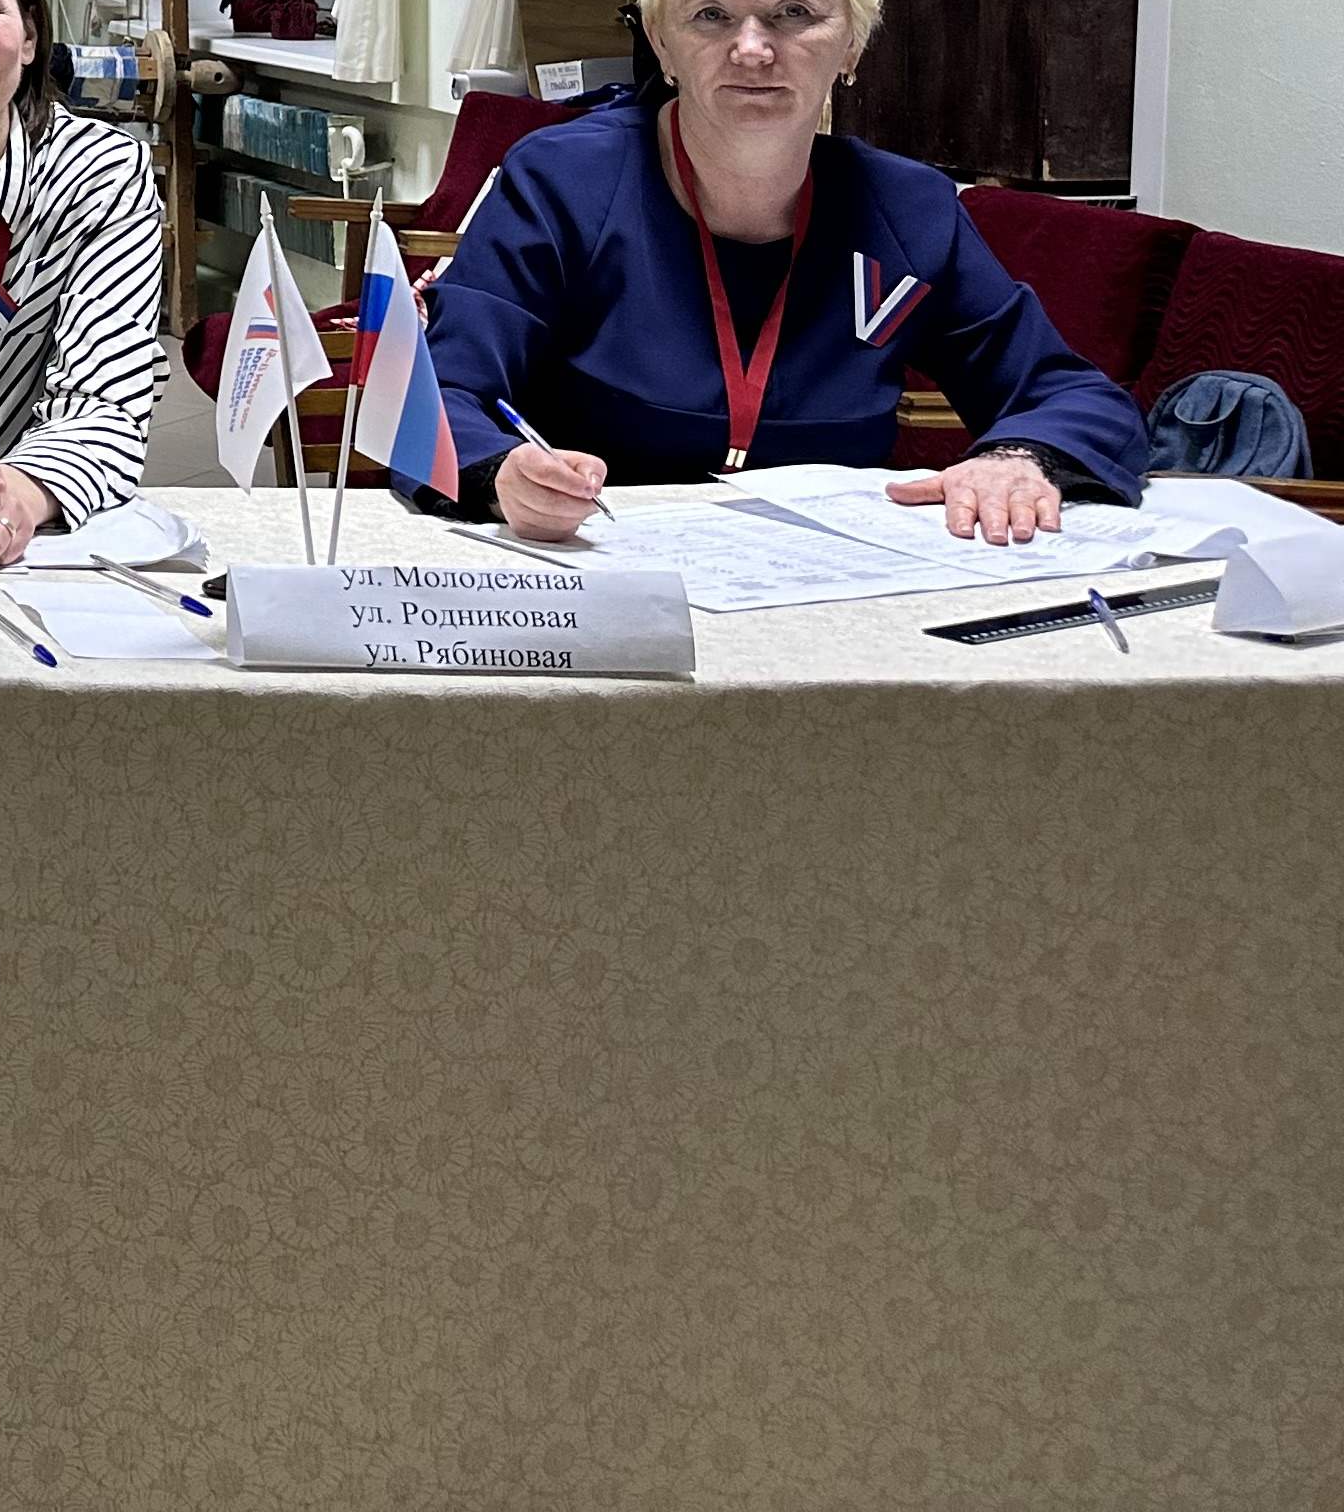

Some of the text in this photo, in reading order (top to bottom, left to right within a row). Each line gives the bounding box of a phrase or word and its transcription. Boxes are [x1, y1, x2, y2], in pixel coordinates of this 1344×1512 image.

[340, 566, 585, 592] ул. Молодежная
[349, 601, 578, 630] ул. Родниковая
[364, 640, 572, 669] ул. Рябиновая
